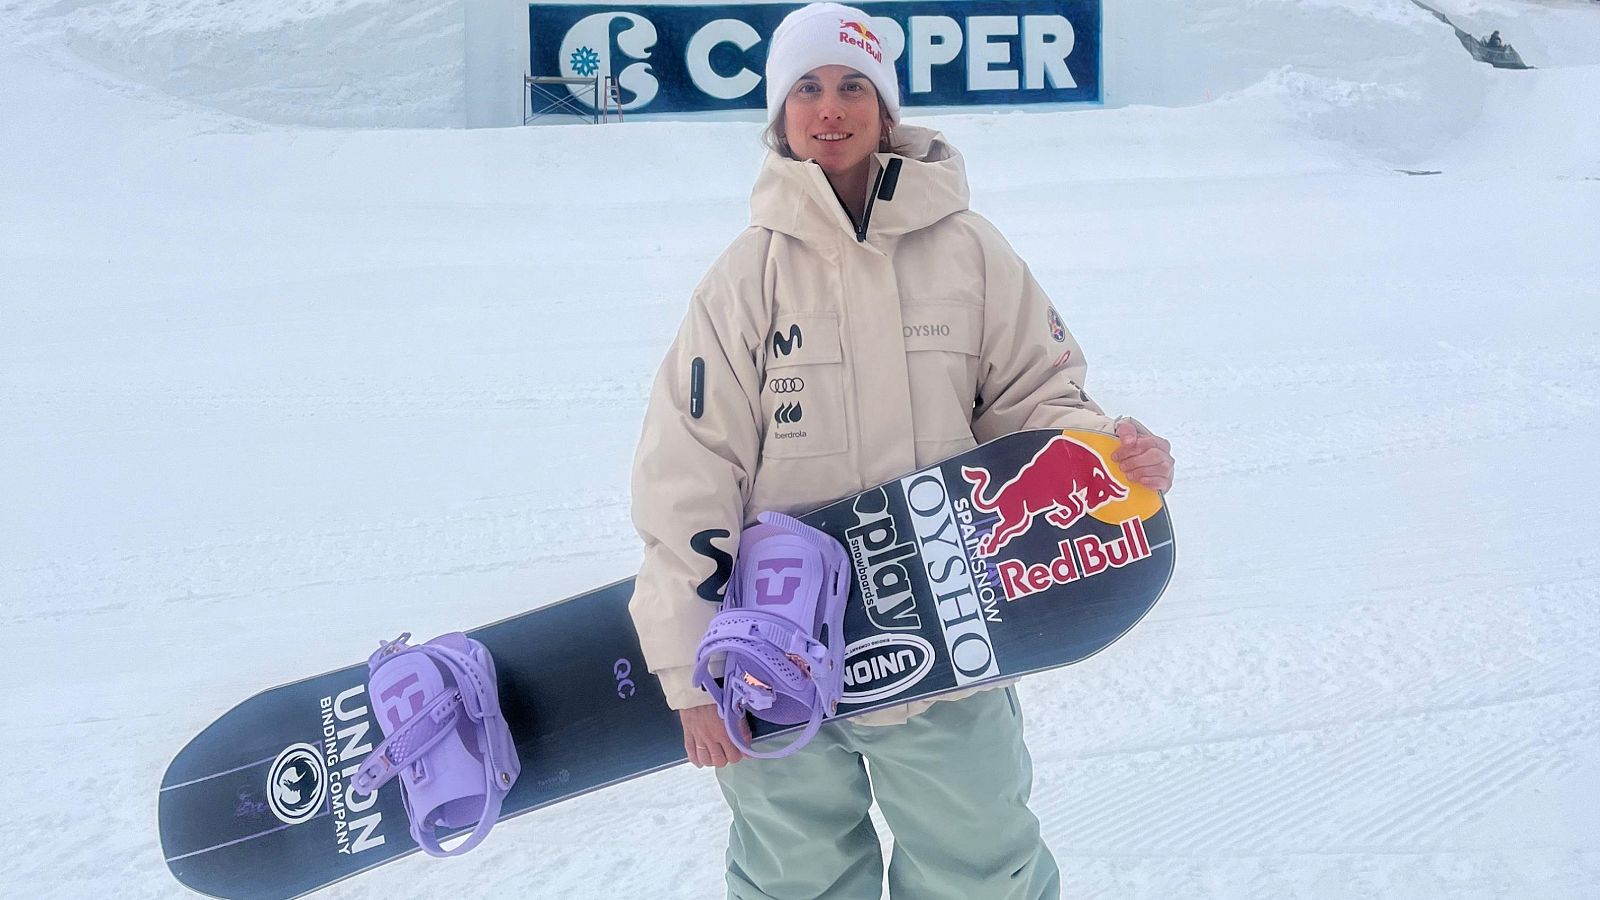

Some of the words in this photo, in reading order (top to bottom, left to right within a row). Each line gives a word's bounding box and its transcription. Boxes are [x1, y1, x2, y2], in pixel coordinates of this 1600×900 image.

[686, 15, 1077, 99] CPER
[839, 32, 864, 49] Red
[865, 42, 882, 64] Bull
[902, 324, 950, 338] OYSHO
[774, 430, 807, 440] Iberdrola
[851, 539, 874, 606] snowboards
[907, 474, 992, 678] OYSHO
[954, 497, 1003, 623] SPAINSNOW
[997, 539, 1078, 602] Red
[1074, 515, 1152, 578] Bull
[320, 696, 339, 768] BINDING
[329, 771, 351, 855] COMPANY
